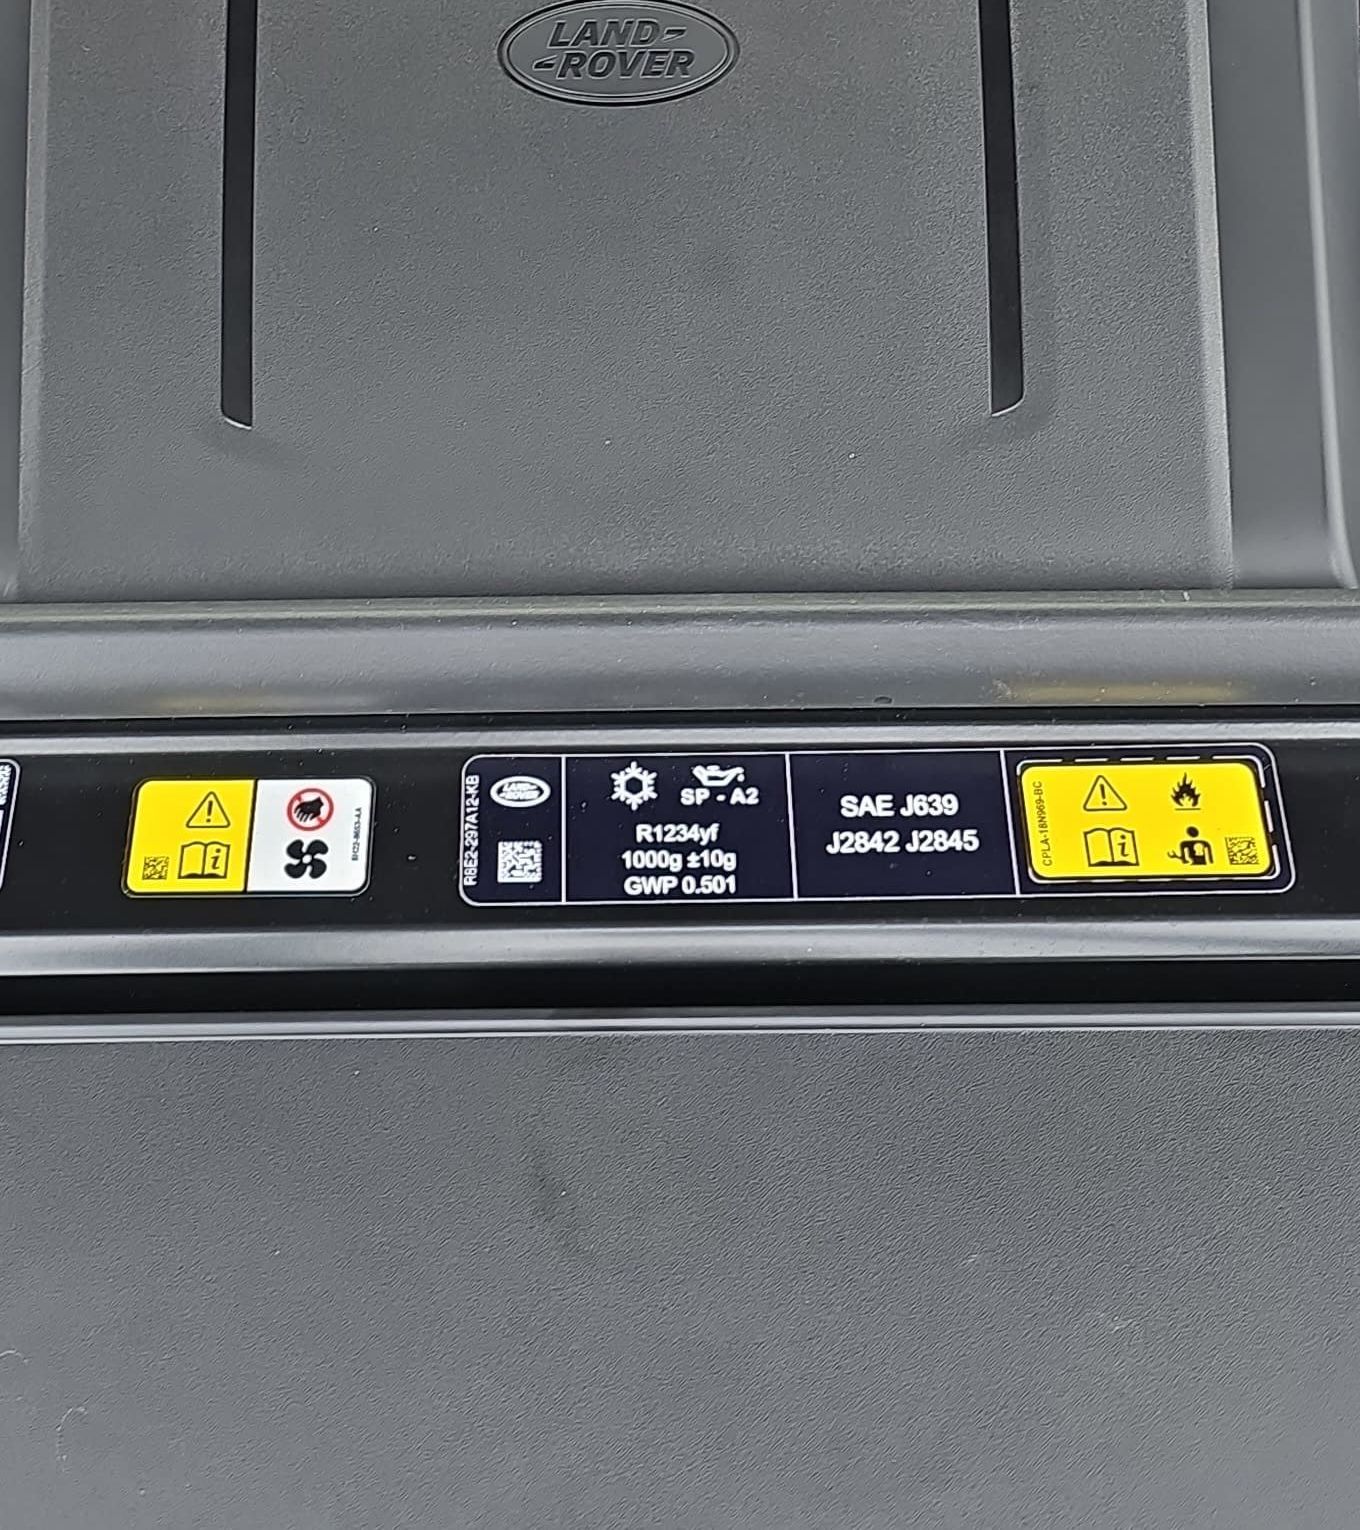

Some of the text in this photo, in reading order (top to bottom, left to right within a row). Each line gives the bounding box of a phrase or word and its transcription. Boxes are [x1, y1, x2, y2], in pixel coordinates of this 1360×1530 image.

[546, 18, 661, 48] LAND
[556, 49, 696, 79] ROVER
[680, 788, 710, 805] SP
[730, 787, 759, 805] A2
[840, 793, 959, 817] SAE J639
[635, 823, 720, 846] R1234yf
[826, 829, 980, 854] J2842 J2845
[622, 849, 737, 872] 1000g ±10g
[624, 875, 736, 895] GWP 0.501
